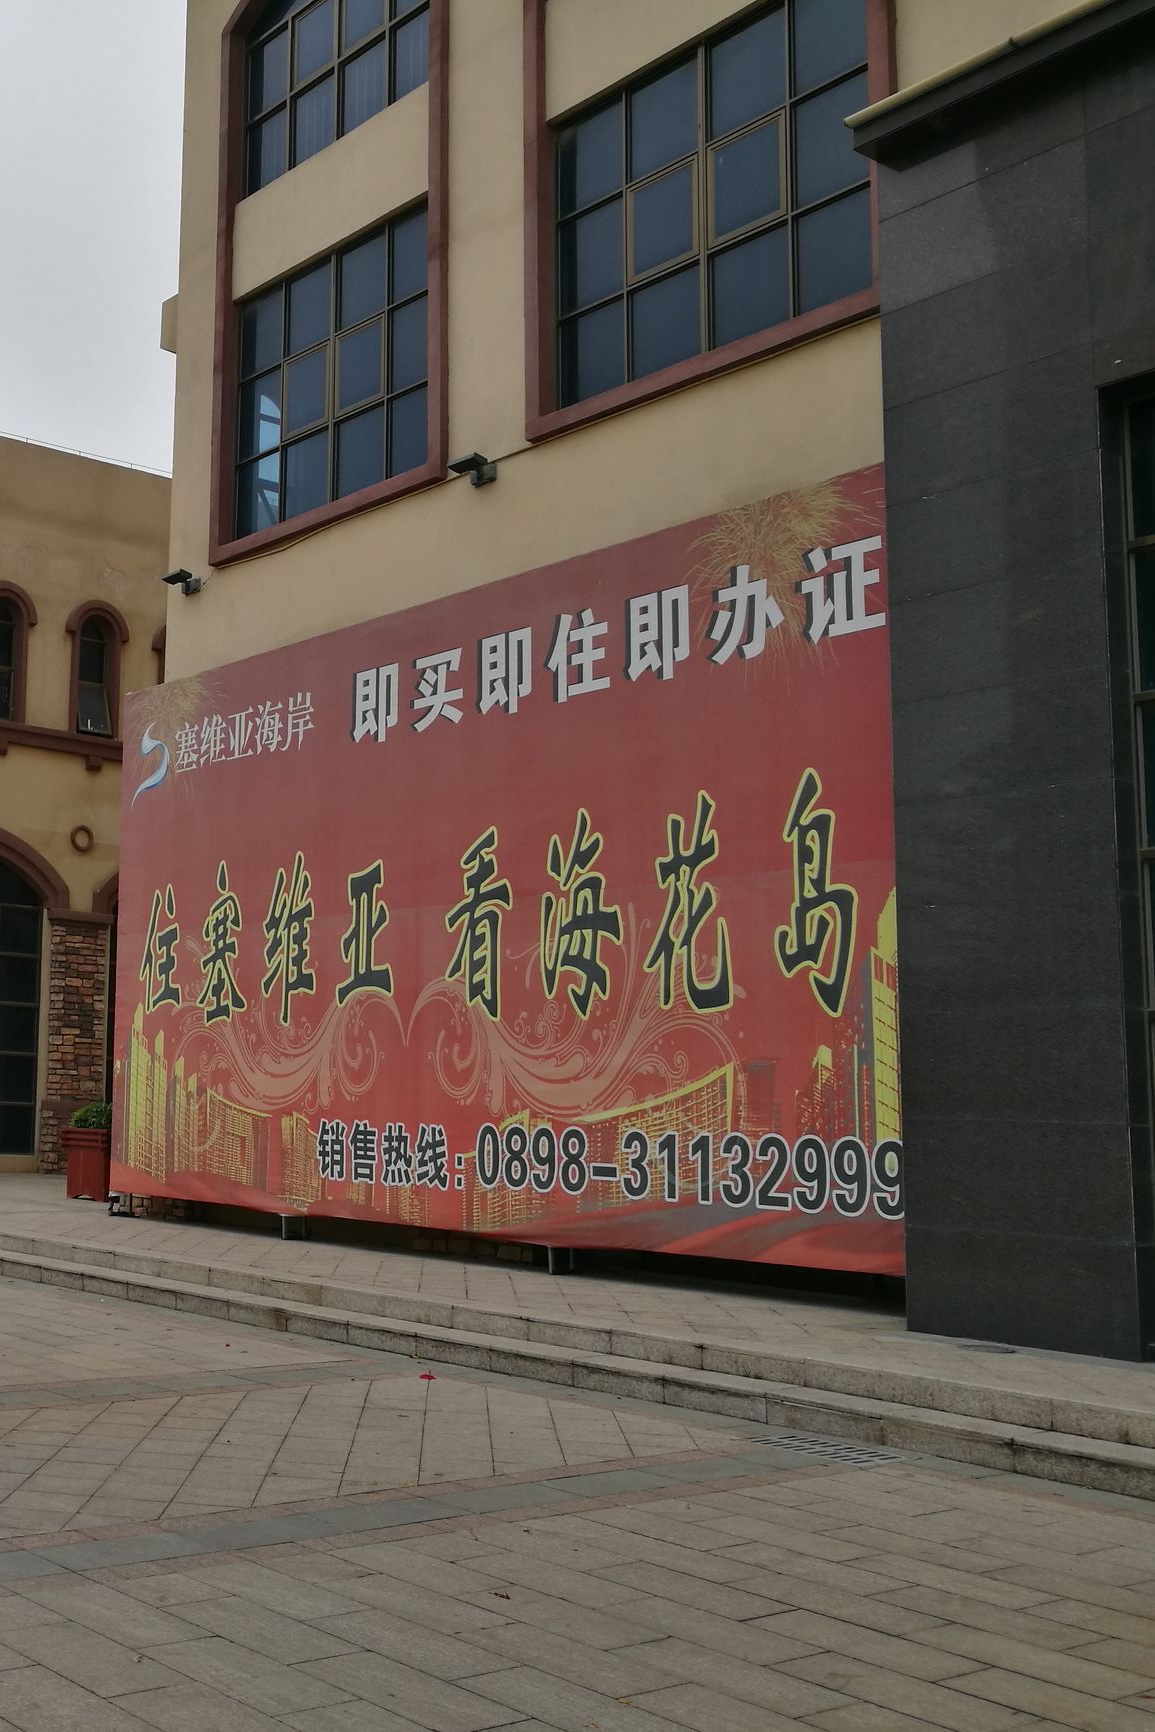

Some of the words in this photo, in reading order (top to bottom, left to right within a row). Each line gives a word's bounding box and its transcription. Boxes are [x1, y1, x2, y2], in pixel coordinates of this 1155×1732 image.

[351, 535, 885, 744] 即买即住即办证
[174, 692, 315, 774] 塞维亚海岸
